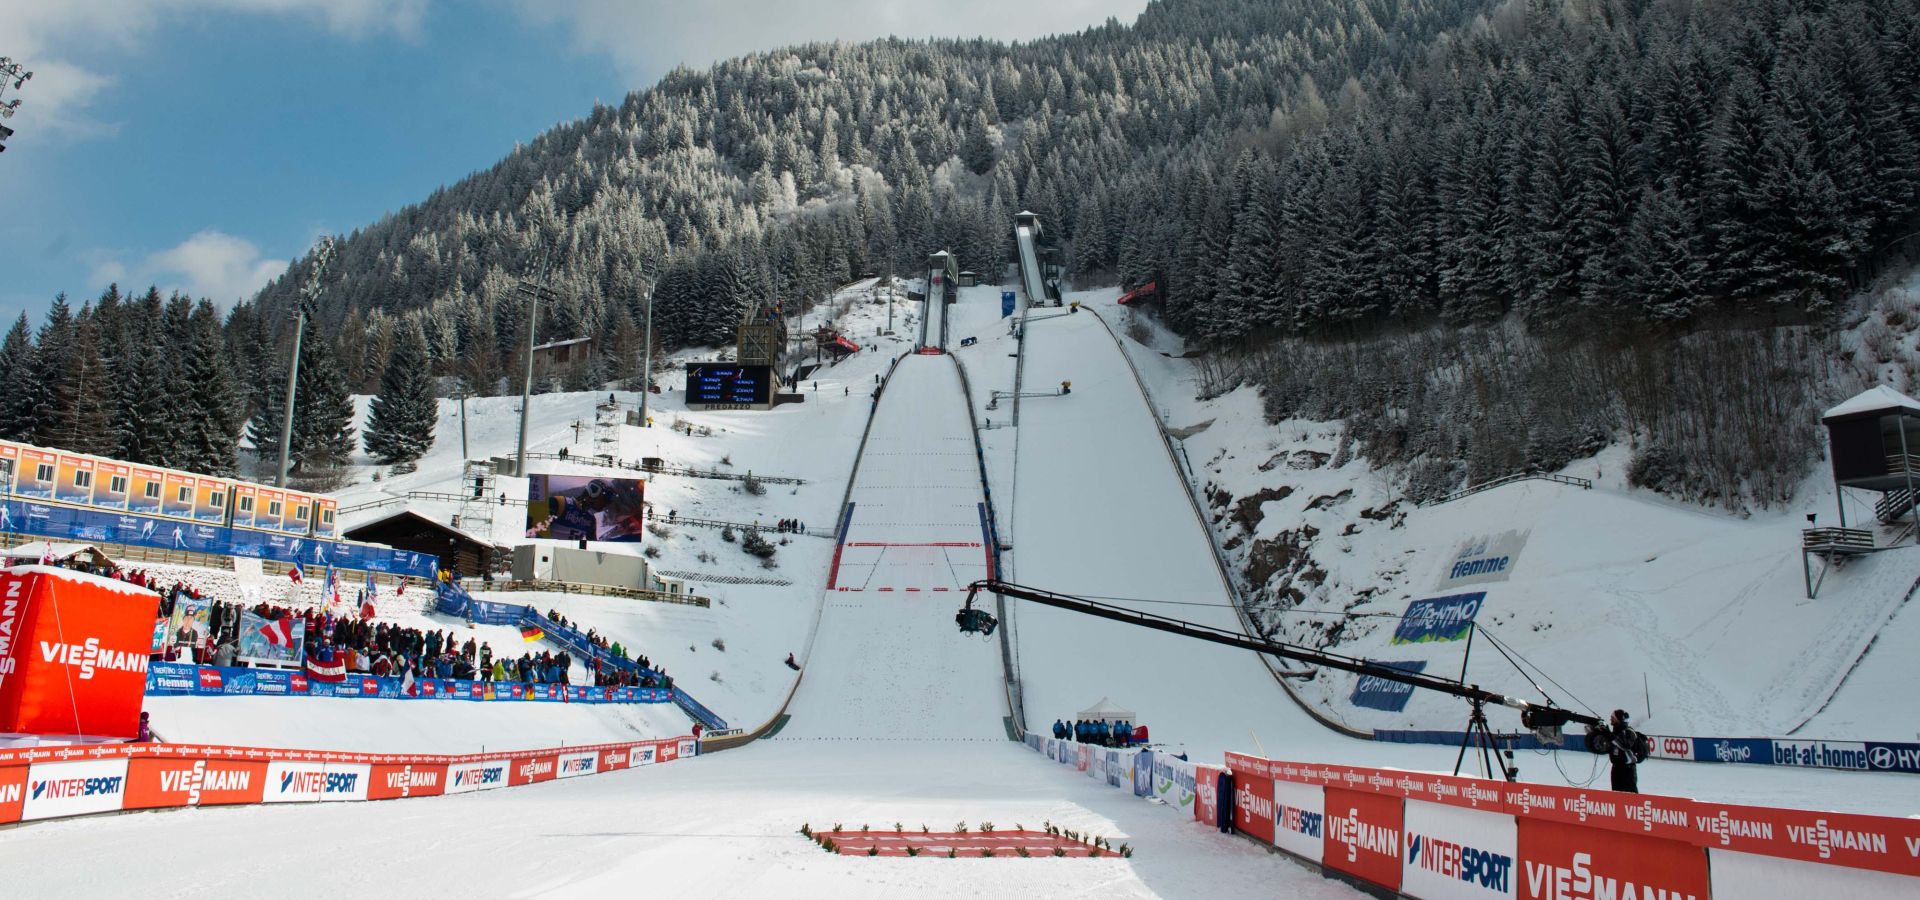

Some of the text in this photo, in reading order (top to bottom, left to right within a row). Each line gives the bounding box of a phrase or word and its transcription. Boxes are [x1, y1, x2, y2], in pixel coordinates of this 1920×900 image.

[1449, 555, 1509, 579] fiemme
[1417, 599, 1478, 630] TRENTINO
[40, 637, 150, 680] VIESSMANN
[18, 749, 51, 762] VIESSMANN
[54, 748, 84, 760] VIESSMANN
[88, 746, 117, 758] VIESSMANN
[1664, 738, 1689, 758] coop
[1713, 743, 1751, 763] TRENTINO
[1775, 740, 1867, 769] bet-at-home
[160, 760, 250, 805] VIESSMANN
[293, 771, 358, 793] INTERSPORT
[386, 765, 438, 796] VIESSMANN
[462, 767, 503, 786] INTERSPORT
[519, 758, 553, 784] VIESSMANN
[1318, 767, 1341, 784] VIESSMANN
[1343, 769, 1366, 788] VIESSMANN
[1368, 772, 1394, 791] VIESSMANN
[46, 776, 122, 800] INTERSPORT
[1396, 775, 1424, 796] VIESSMANN
[1427, 778, 1458, 800] VIESSMANN
[1461, 782, 1498, 807] VIESSMANN
[1233, 783, 1272, 824] VIESSMANN
[1506, 788, 1556, 814] VIESSMANN
[1562, 793, 1616, 822] VIESSMANN
[1282, 806, 1323, 839] INTERSPORT
[1624, 800, 1688, 832] VIESSMANN
[1696, 810, 1773, 846] VIESSMANN
[1328, 808, 1399, 863] VIESSMANN
[1787, 819, 1887, 859] VIESSMANN
[1421, 835, 1511, 893] INTERSPORT
